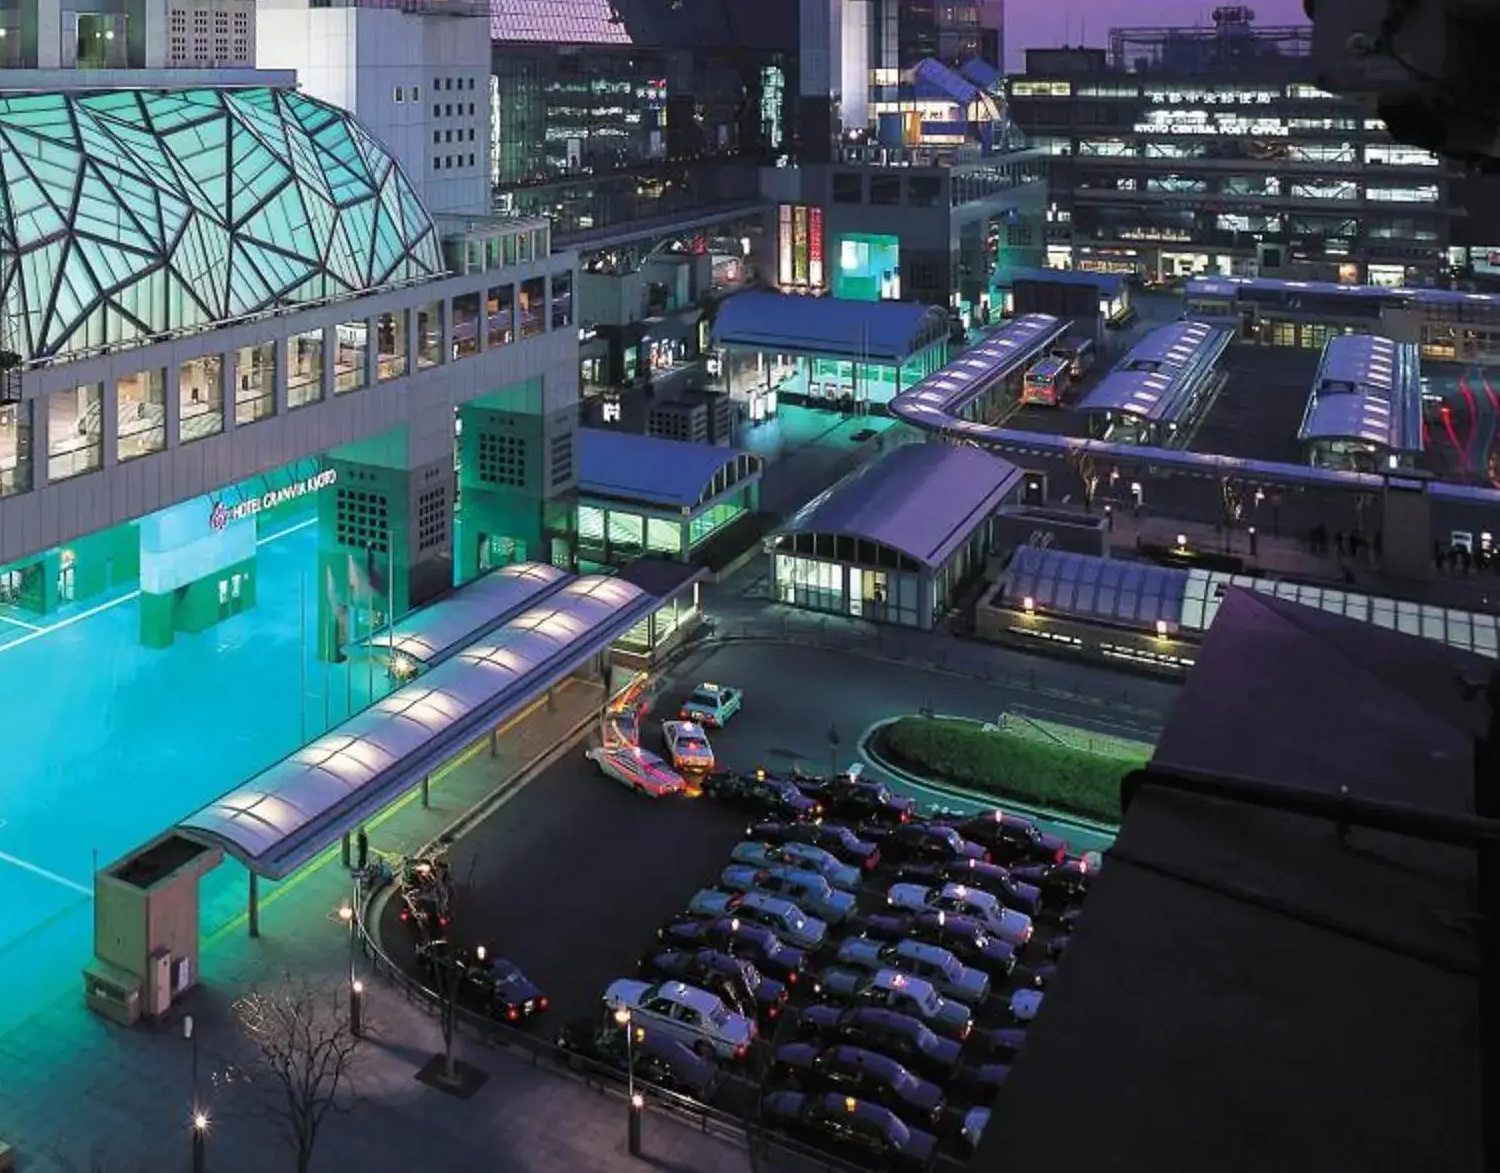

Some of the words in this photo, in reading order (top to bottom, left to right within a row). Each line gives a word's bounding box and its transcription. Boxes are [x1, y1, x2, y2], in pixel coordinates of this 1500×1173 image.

[1134, 124, 1168, 134] KYOTO
[1171, 124, 1218, 135] CENTRAL
[1220, 125, 1248, 135] POST
[1251, 125, 1289, 136] OFFICE
[233, 500, 262, 520] HOTEL
